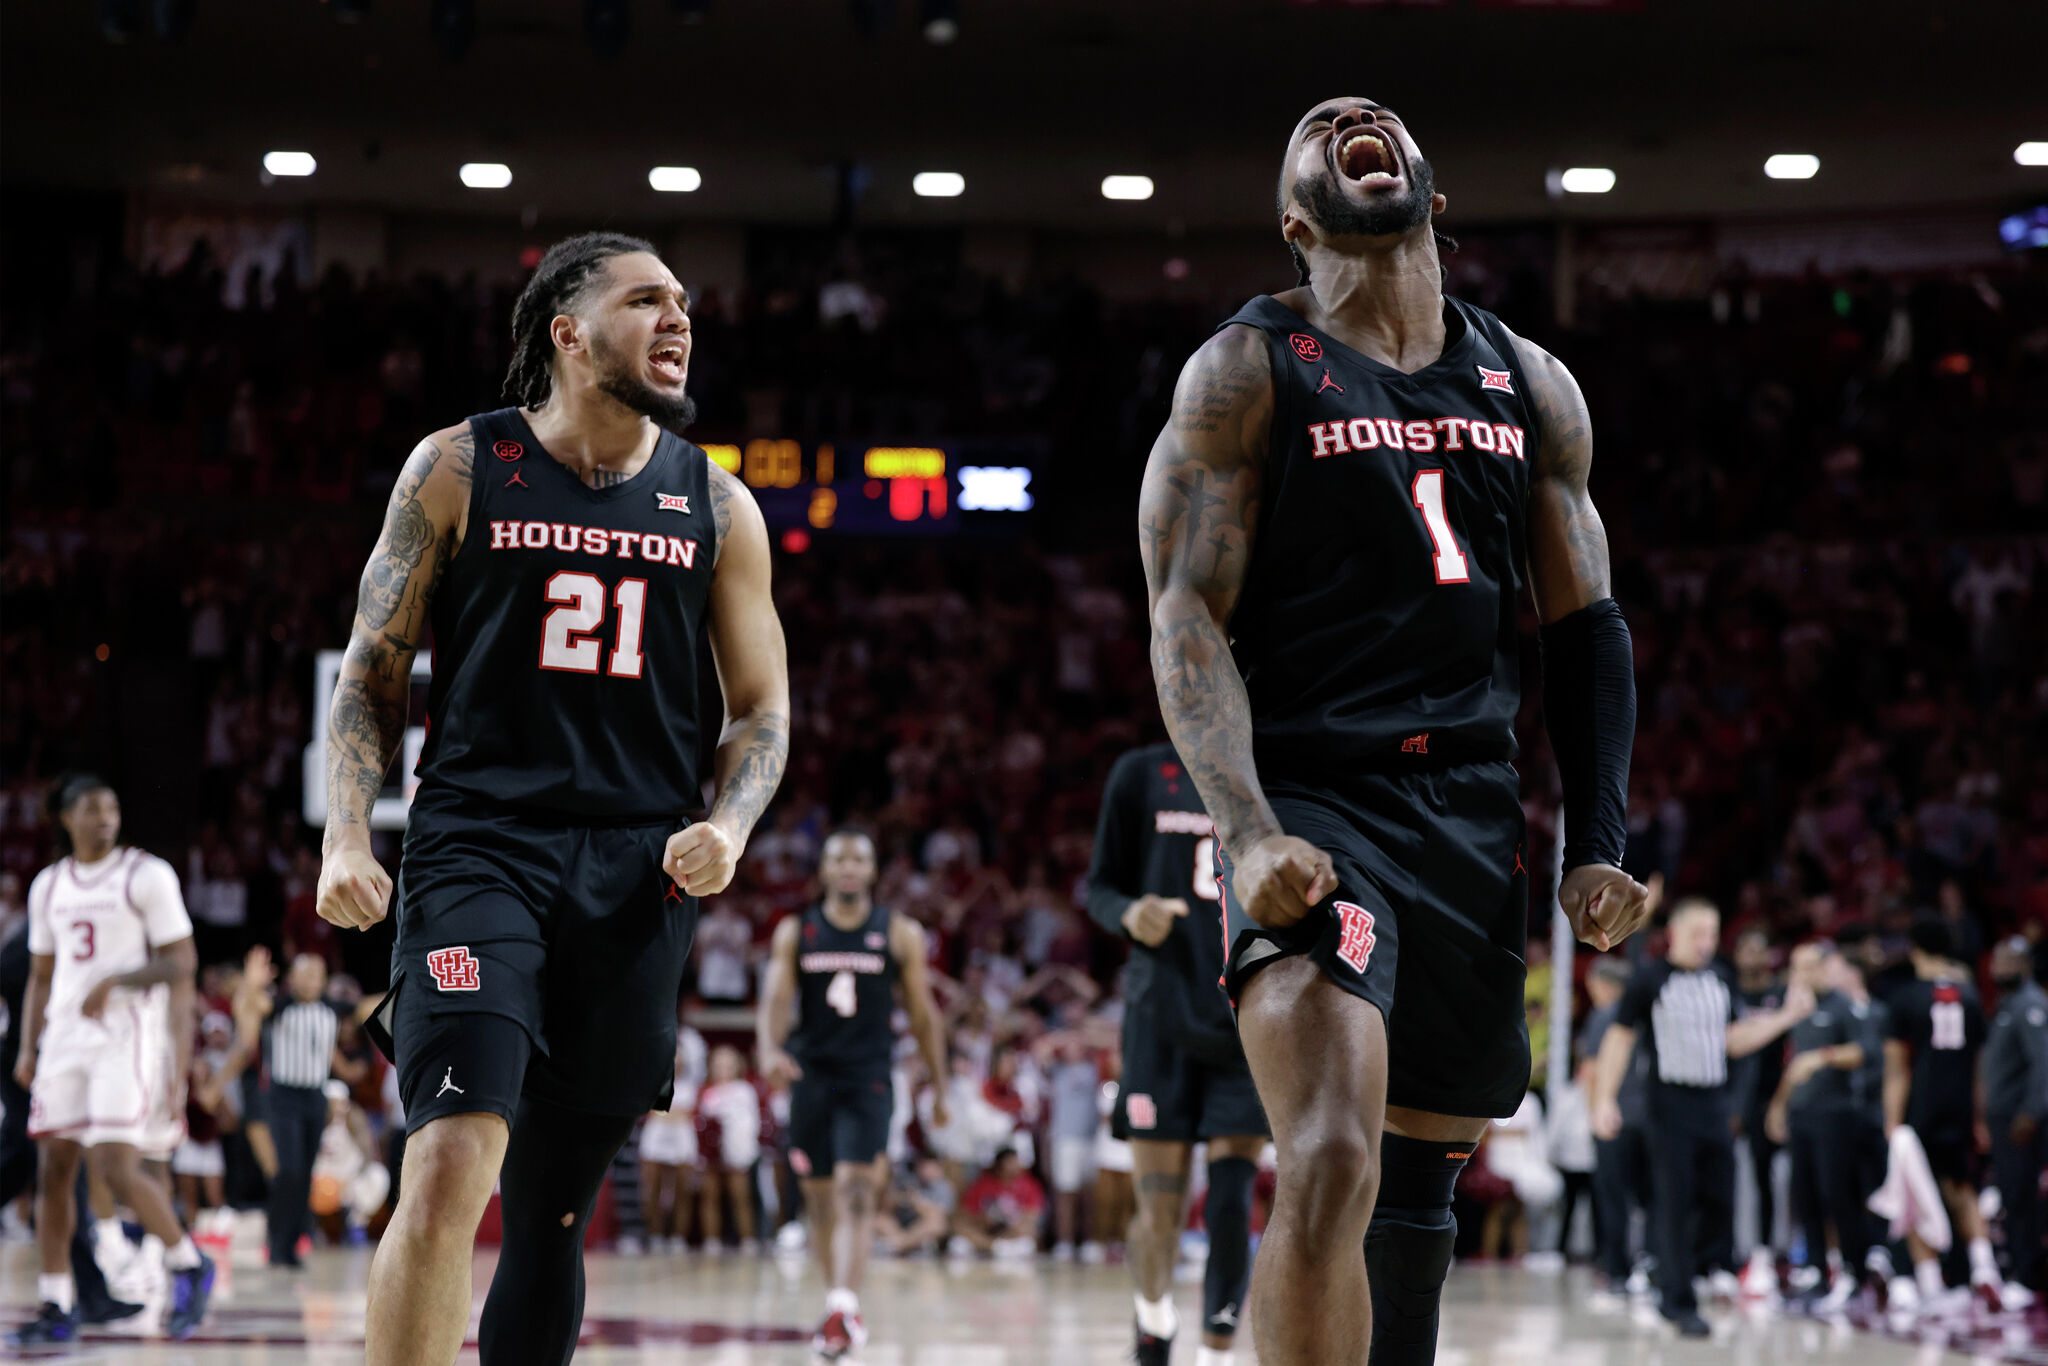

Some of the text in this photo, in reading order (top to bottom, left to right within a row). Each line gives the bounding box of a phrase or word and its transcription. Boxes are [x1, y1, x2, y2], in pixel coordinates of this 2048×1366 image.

[1294, 337, 1319, 356] 32
[1308, 416, 1525, 461] HOUSTON
[490, 520, 697, 570] HOUSTON
[1412, 468, 1471, 585] 1
[538, 569, 648, 679] 21
[72, 920, 95, 962] 3
[826, 970, 857, 1018] 4
